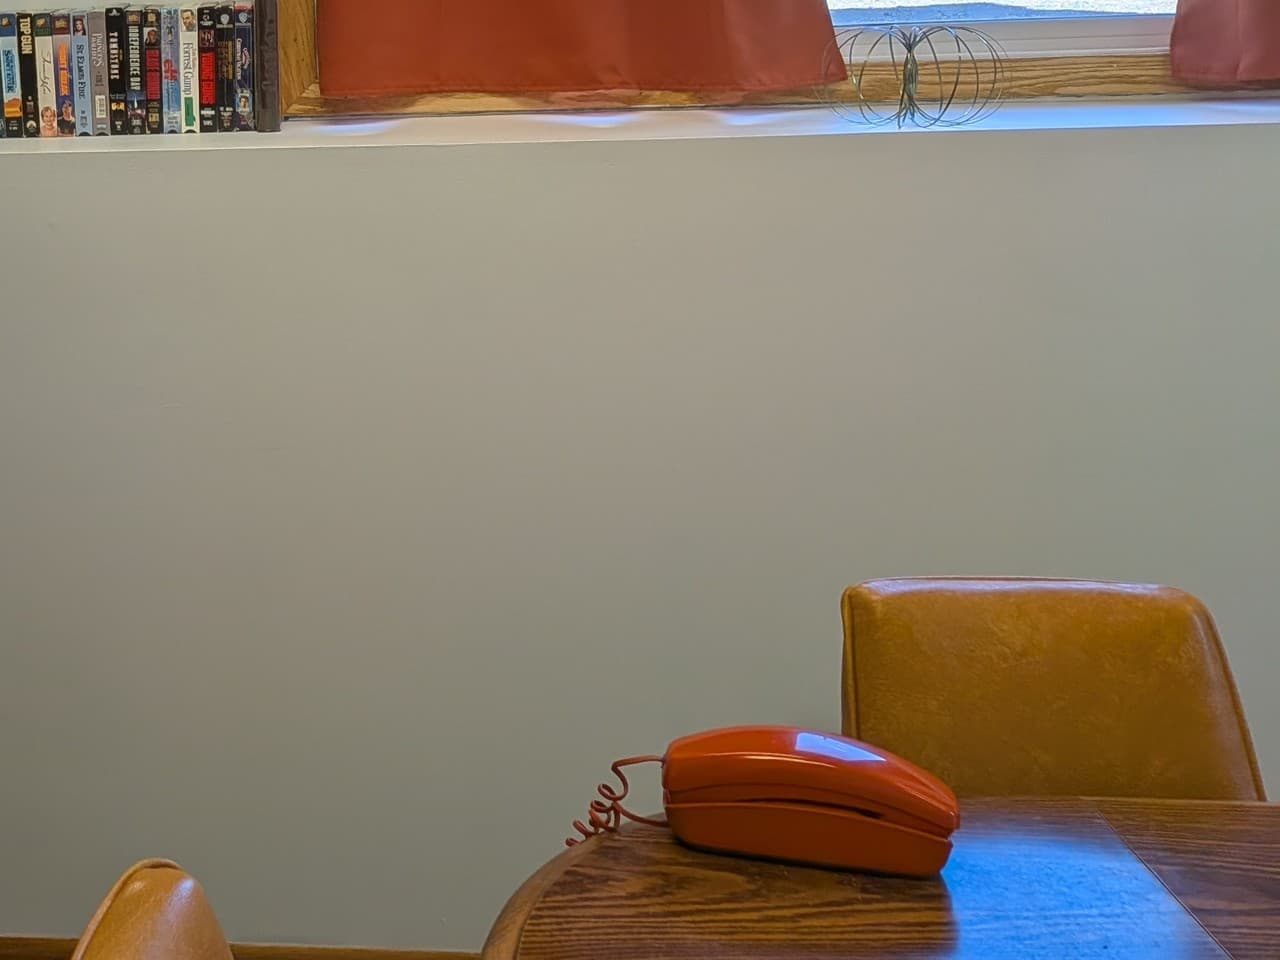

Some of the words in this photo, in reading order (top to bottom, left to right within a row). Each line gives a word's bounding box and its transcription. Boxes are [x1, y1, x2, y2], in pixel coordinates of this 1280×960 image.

[20, 17, 31, 33] TOP
[21, 36, 32, 54] GUN
[110, 32, 119, 80] TOMBSTONE
[128, 26, 140, 76] INDEPENDENCE
[183, 42, 194, 70] Forrest
[130, 77, 141, 90] DAY
[182, 71, 194, 95] Gump
